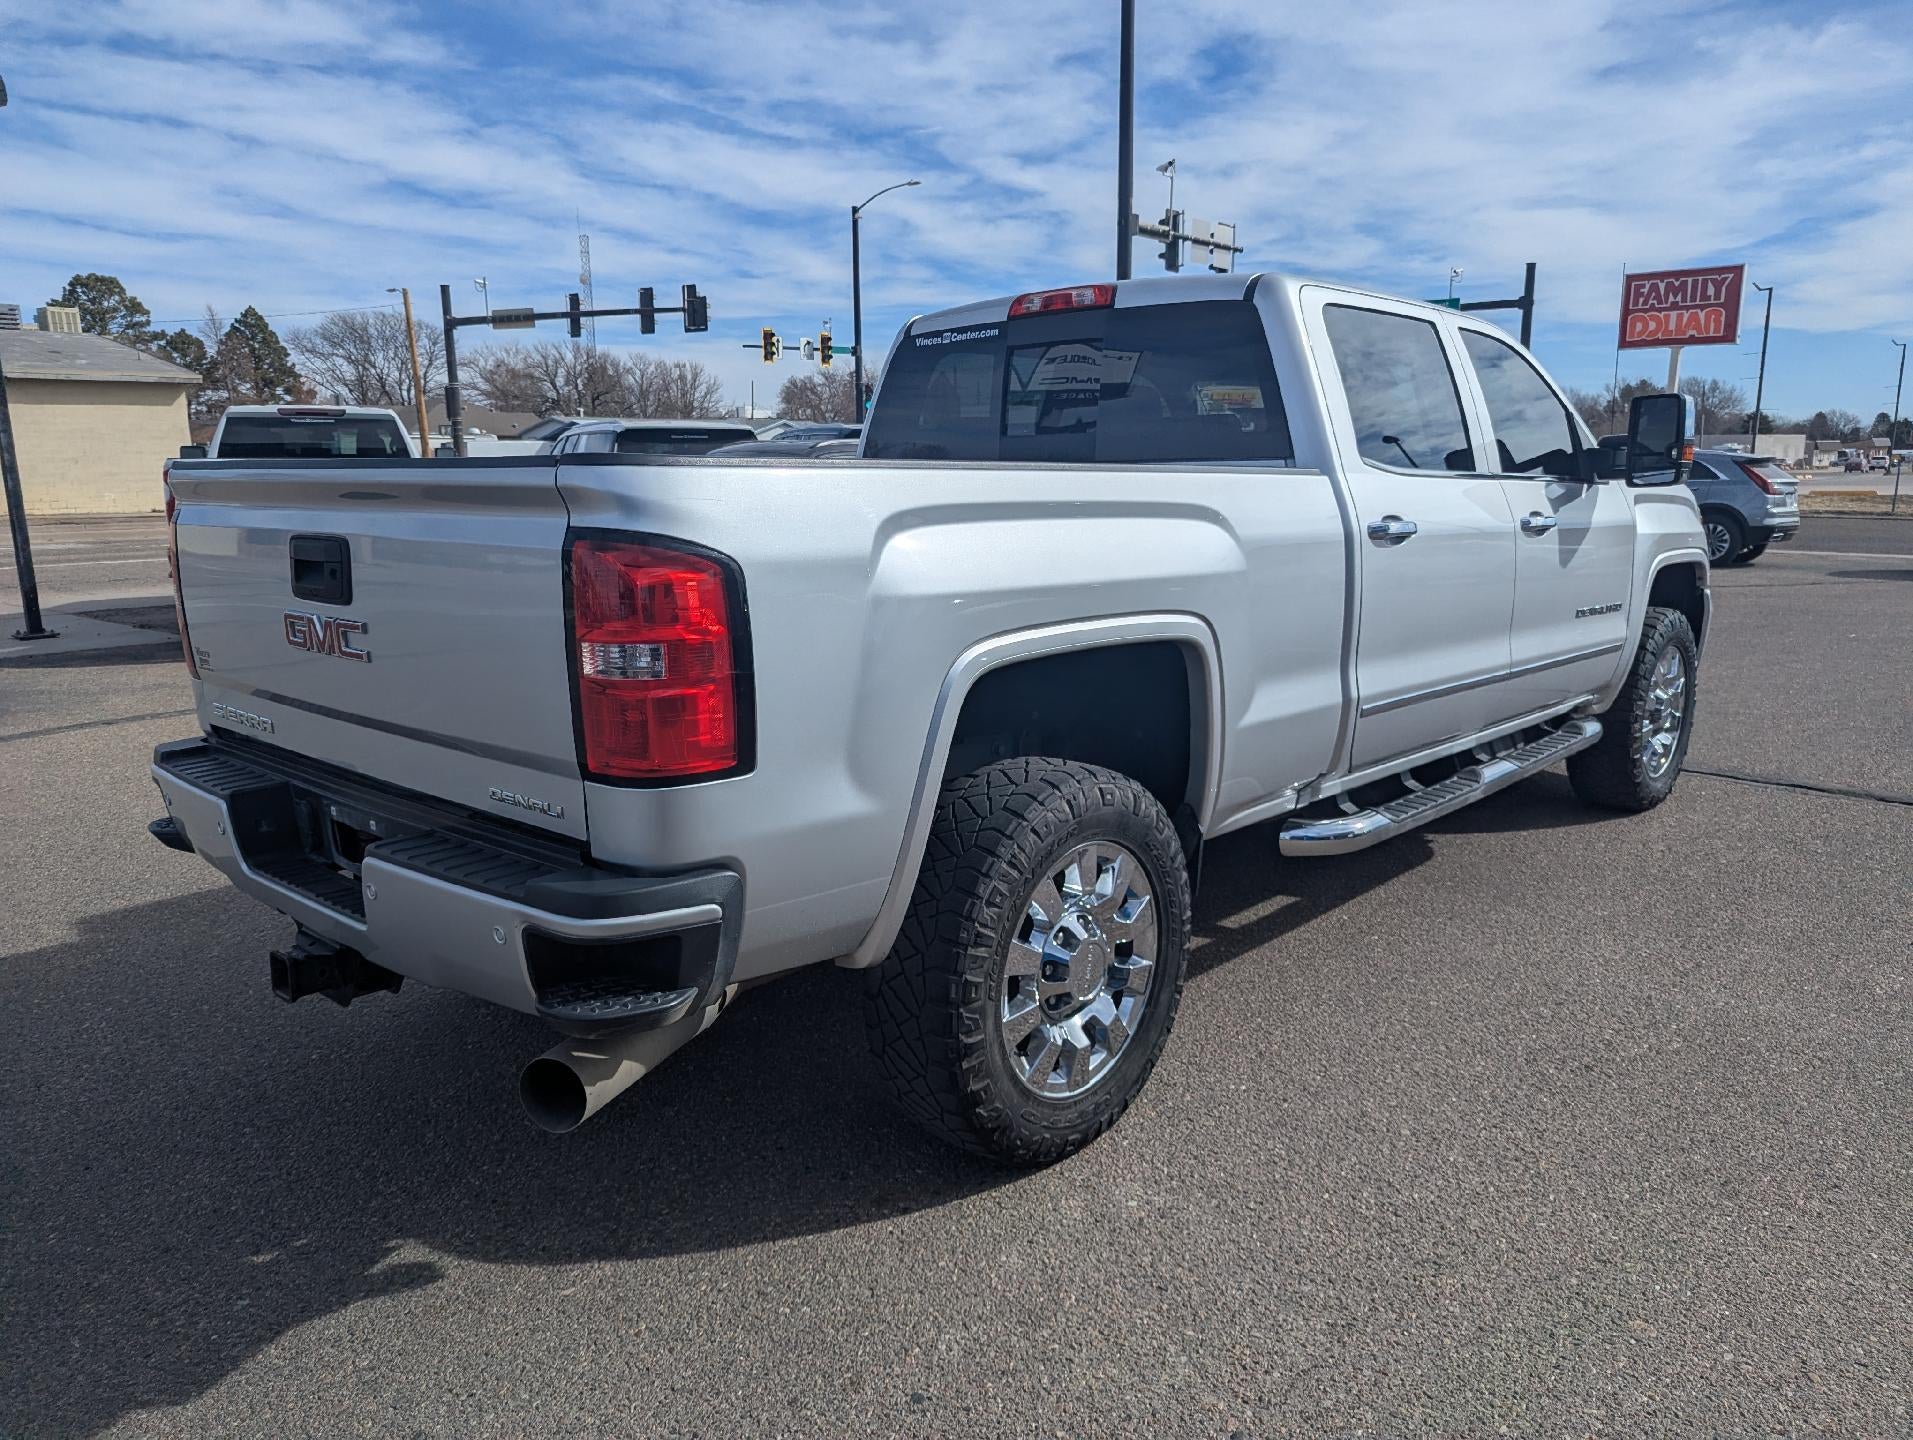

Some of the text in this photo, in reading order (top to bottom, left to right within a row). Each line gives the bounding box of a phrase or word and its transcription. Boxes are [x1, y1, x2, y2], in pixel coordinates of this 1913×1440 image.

[1629, 274, 1734, 309] FAMILY
[1626, 307, 1726, 341] DOLLAR
[284, 610, 371, 662] GMC
[212, 702, 275, 734] SIERRA
[489, 787, 565, 819] DENALI
